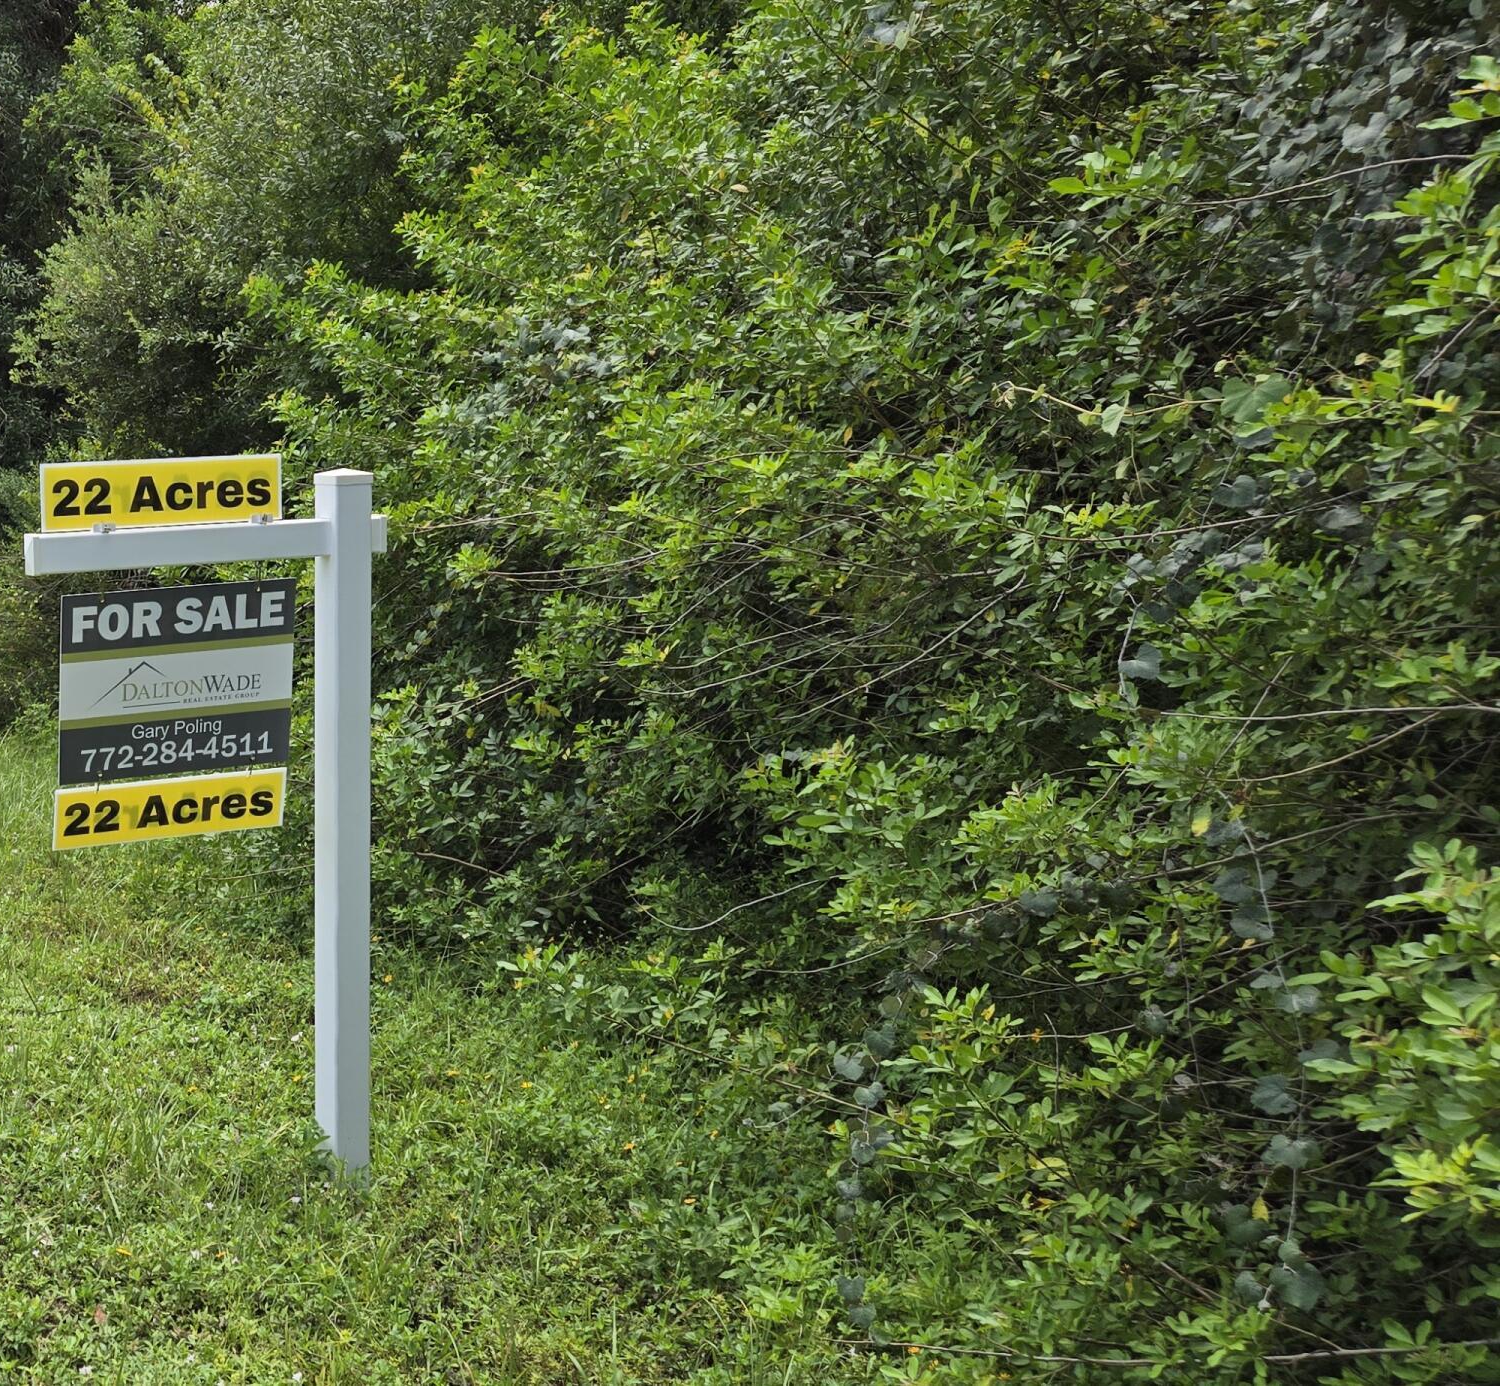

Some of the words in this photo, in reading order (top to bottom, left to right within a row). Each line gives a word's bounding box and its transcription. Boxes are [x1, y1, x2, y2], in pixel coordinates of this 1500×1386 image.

[52, 478, 111, 517] 22
[130, 475, 272, 513] Acres
[71, 601, 163, 643] FOR
[174, 591, 285, 635] SALE
[205, 694, 232, 702] ESTATE
[131, 724, 170, 740] Gary
[174, 719, 222, 735] Poling
[80, 731, 273, 773] 772-284-4511
[63, 799, 120, 837] 22
[138, 790, 274, 829] Acres
